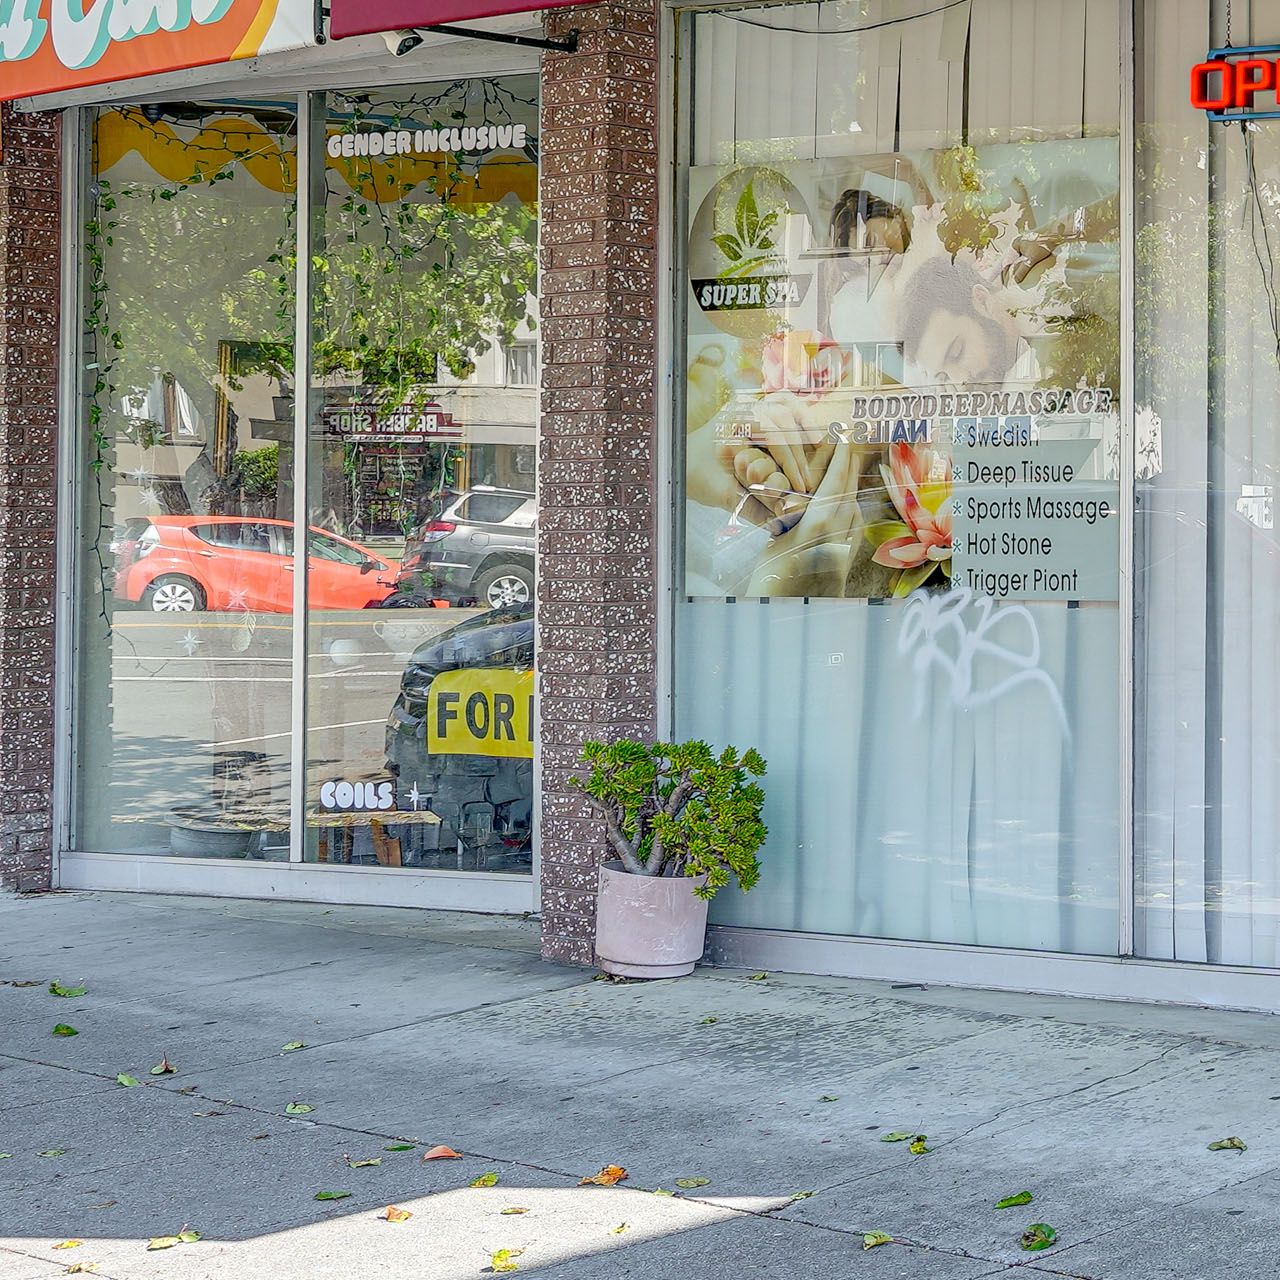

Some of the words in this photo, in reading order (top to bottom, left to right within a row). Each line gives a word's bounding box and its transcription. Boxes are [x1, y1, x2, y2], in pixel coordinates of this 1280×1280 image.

[327, 131, 412, 158] GENDER
[414, 124, 527, 153] INCLUSIVE
[701, 284, 761, 307] SUPER
[765, 281, 800, 305] SPA
[853, 395, 917, 419] BODY
[919, 392, 989, 418] DEEP
[989, 388, 1113, 416] MASSAGE
[967, 425, 1040, 448] Swedish
[967, 461, 1017, 488] Deep
[1021, 460, 1074, 483] Tissue
[967, 497, 1022, 523] Sports
[1027, 496, 1110, 524] Massage
[967, 533, 997, 555] Hot
[1001, 532, 1052, 555] Stone
[967, 569, 1029, 597] Trigger
[1033, 569, 1078, 593] Piont
[437, 691, 516, 741] FOR
[320, 781, 395, 809] COILS
